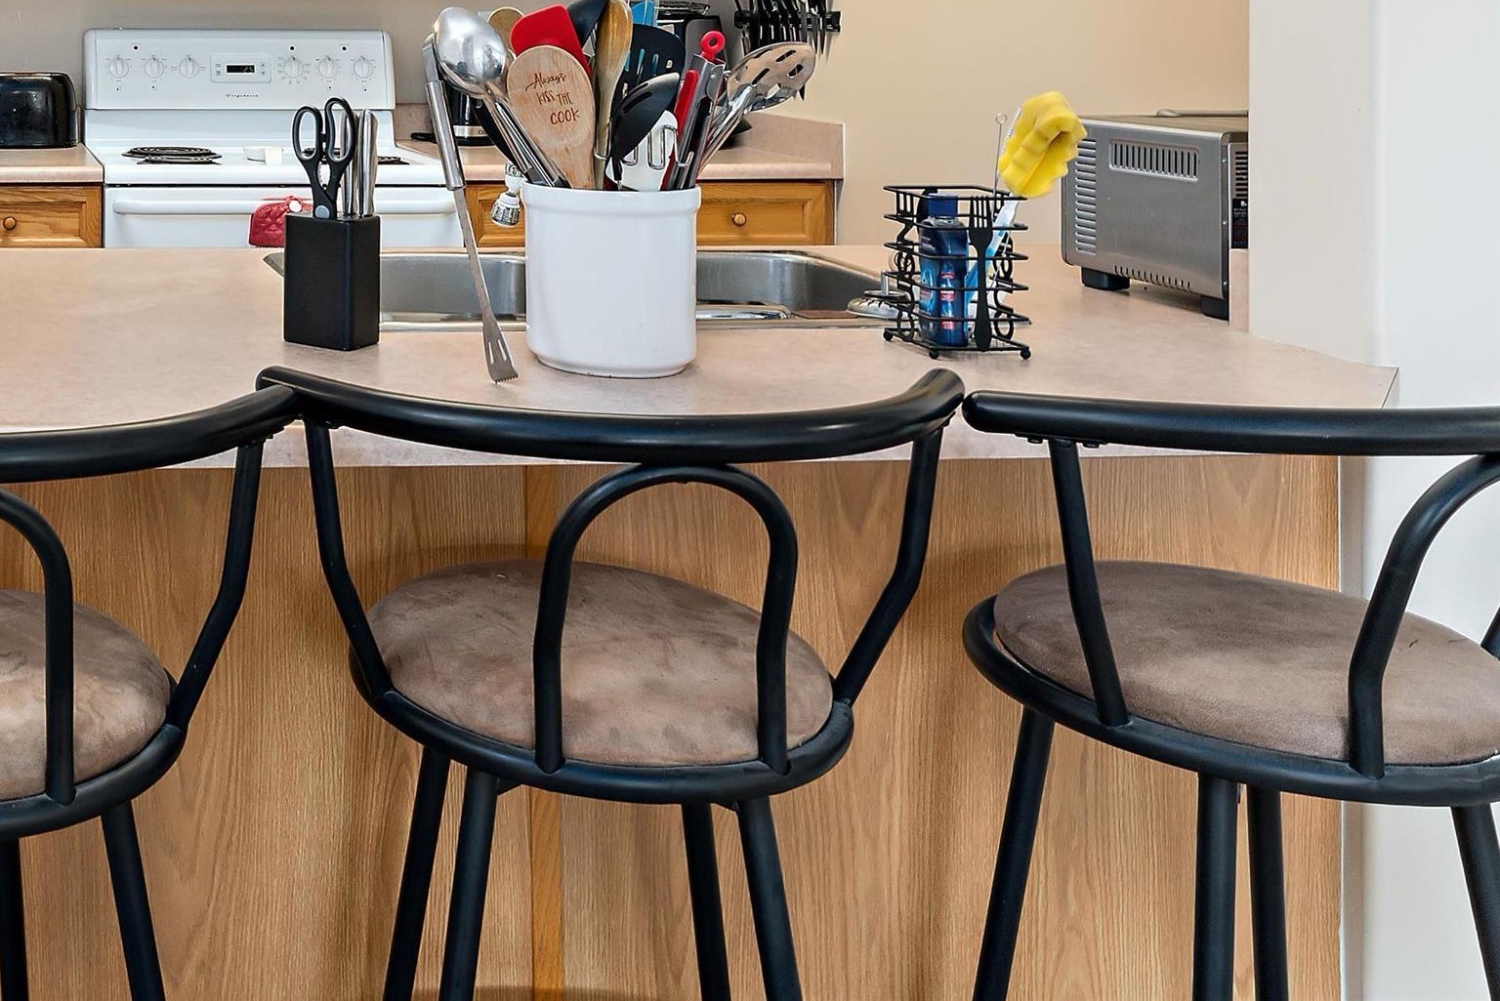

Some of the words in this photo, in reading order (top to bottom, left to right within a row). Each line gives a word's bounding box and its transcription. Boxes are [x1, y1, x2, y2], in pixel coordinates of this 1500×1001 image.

[525, 72, 567, 92] Always
[536, 90, 555, 105] KISS
[556, 92, 574, 106] THE
[550, 108, 580, 125] COOK
